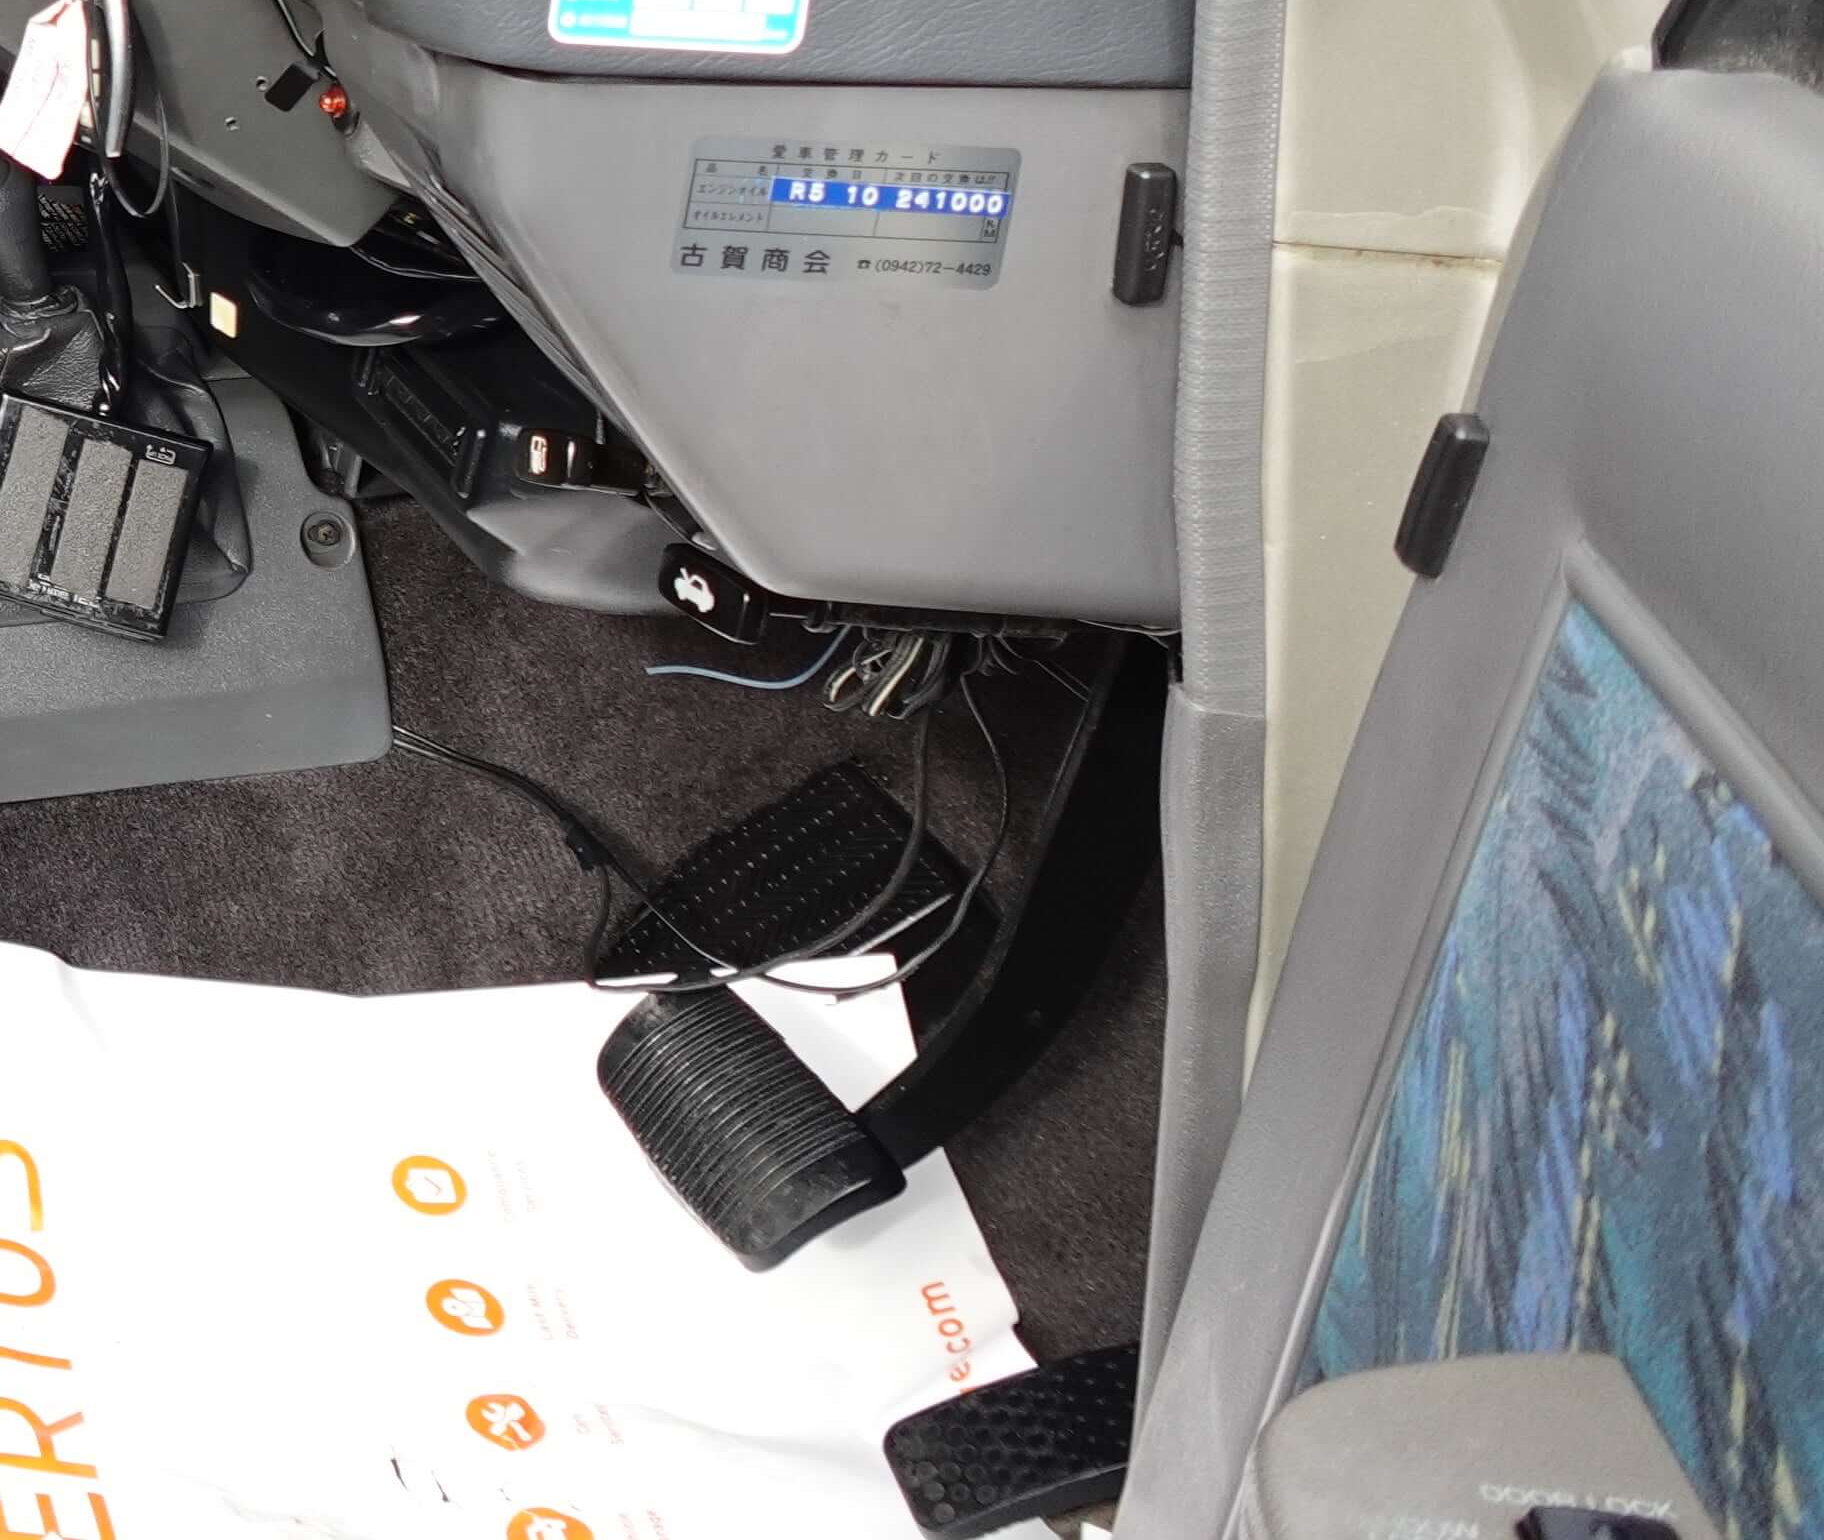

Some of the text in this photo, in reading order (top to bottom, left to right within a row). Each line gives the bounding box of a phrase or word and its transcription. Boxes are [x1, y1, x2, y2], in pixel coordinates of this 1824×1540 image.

[788, 182, 1005, 215] R5 10 241000
[680, 243, 832, 276] 古賀商会
